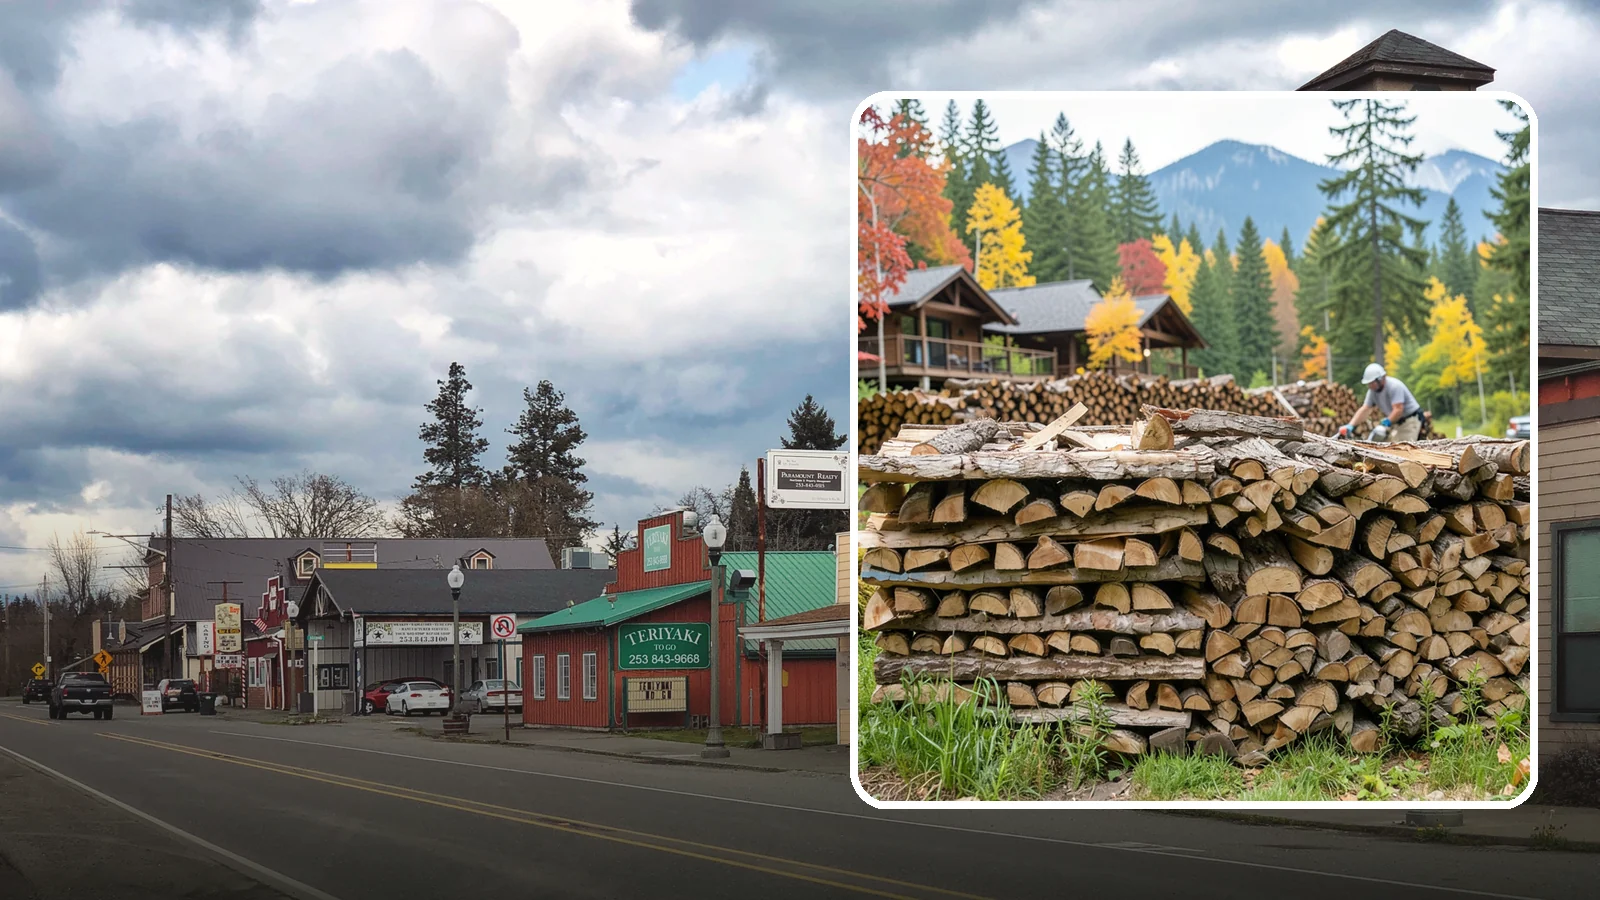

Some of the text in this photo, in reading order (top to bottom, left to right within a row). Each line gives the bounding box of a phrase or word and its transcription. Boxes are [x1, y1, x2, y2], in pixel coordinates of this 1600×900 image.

[625, 627, 702, 646] TERIYAKI
[628, 654, 700, 664] 253 843-9668
